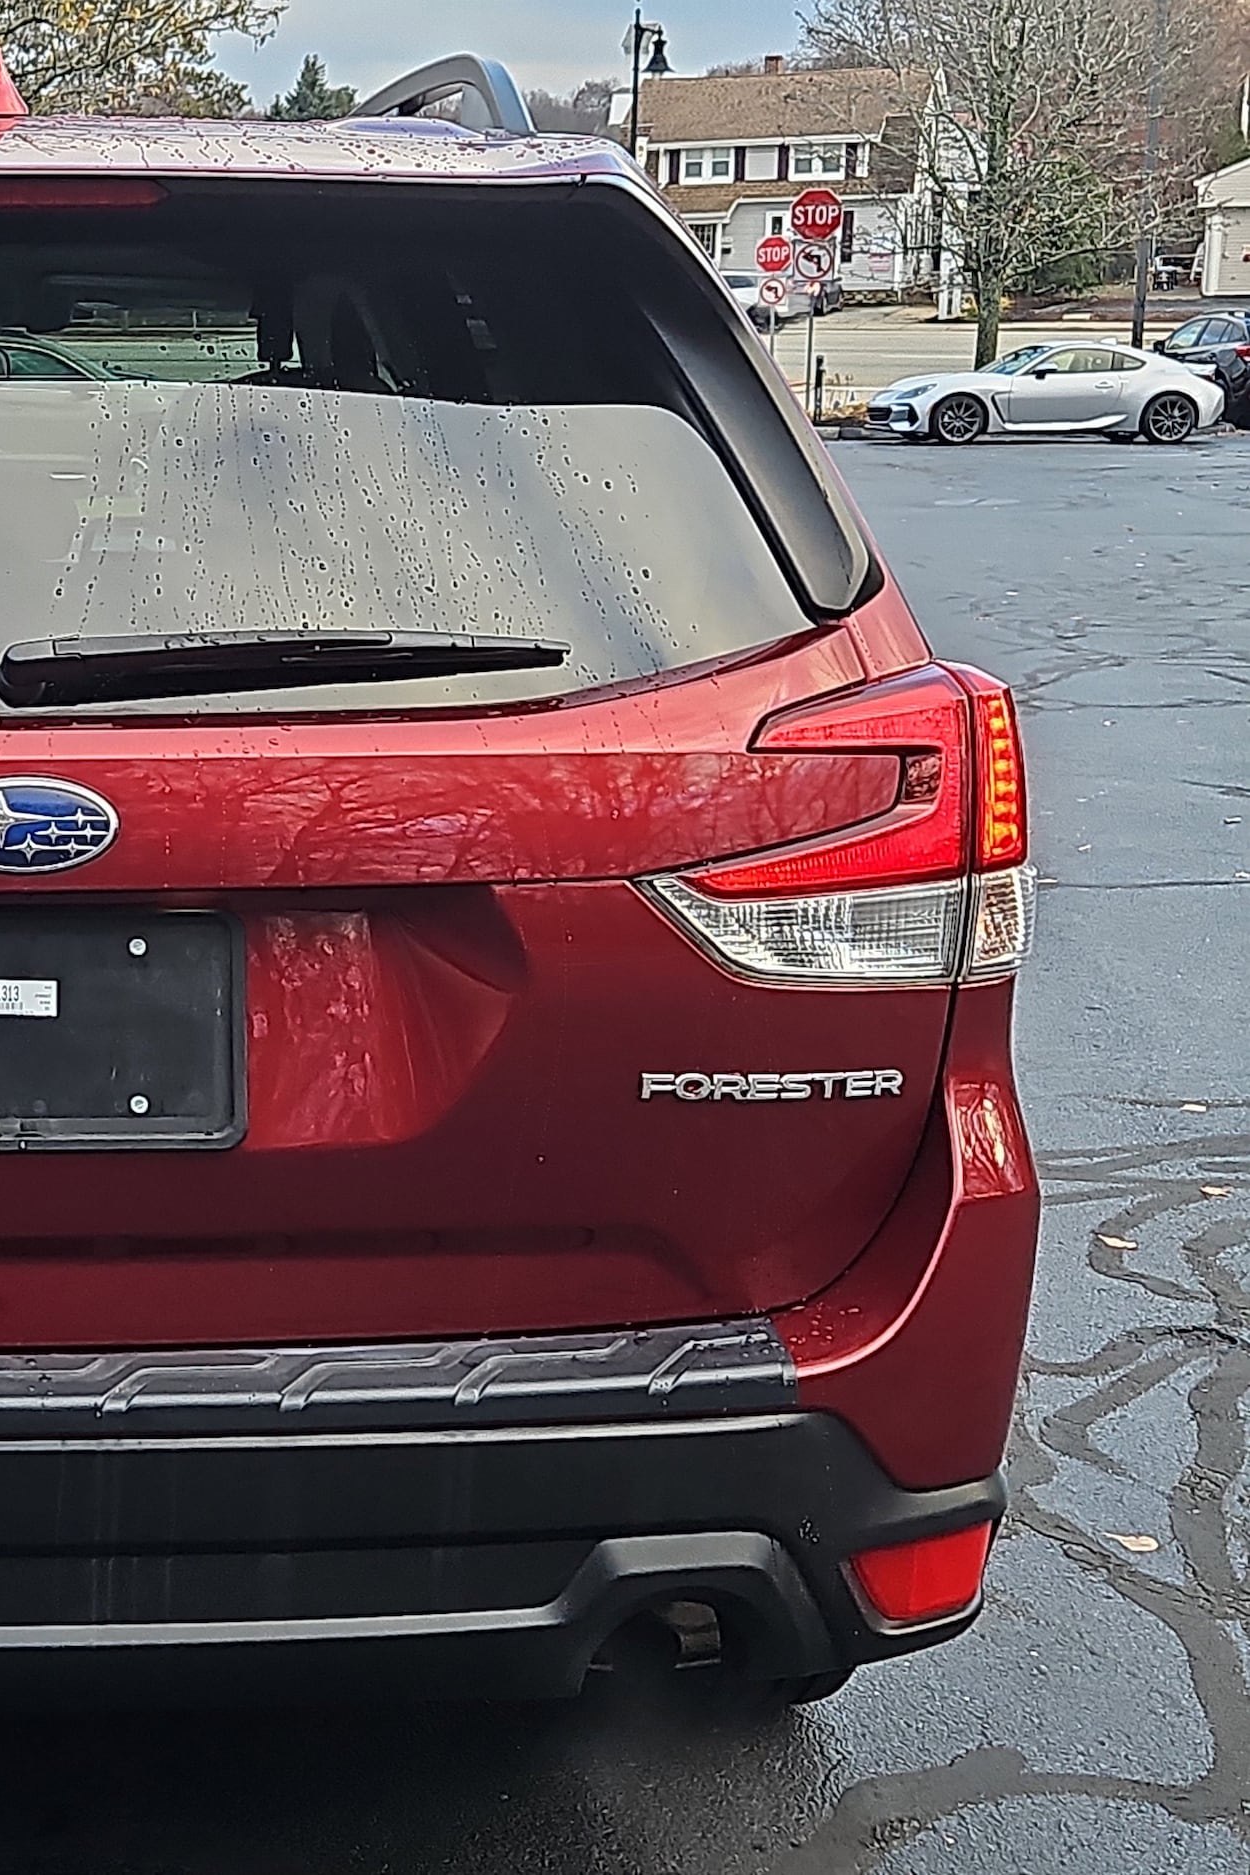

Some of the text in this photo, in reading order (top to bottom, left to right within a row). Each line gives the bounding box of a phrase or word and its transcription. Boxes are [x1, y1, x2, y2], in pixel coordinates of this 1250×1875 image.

[793, 204, 839, 225] STOP
[757, 246, 790, 263] STOP
[641, 1069, 903, 1101] FORESTER
